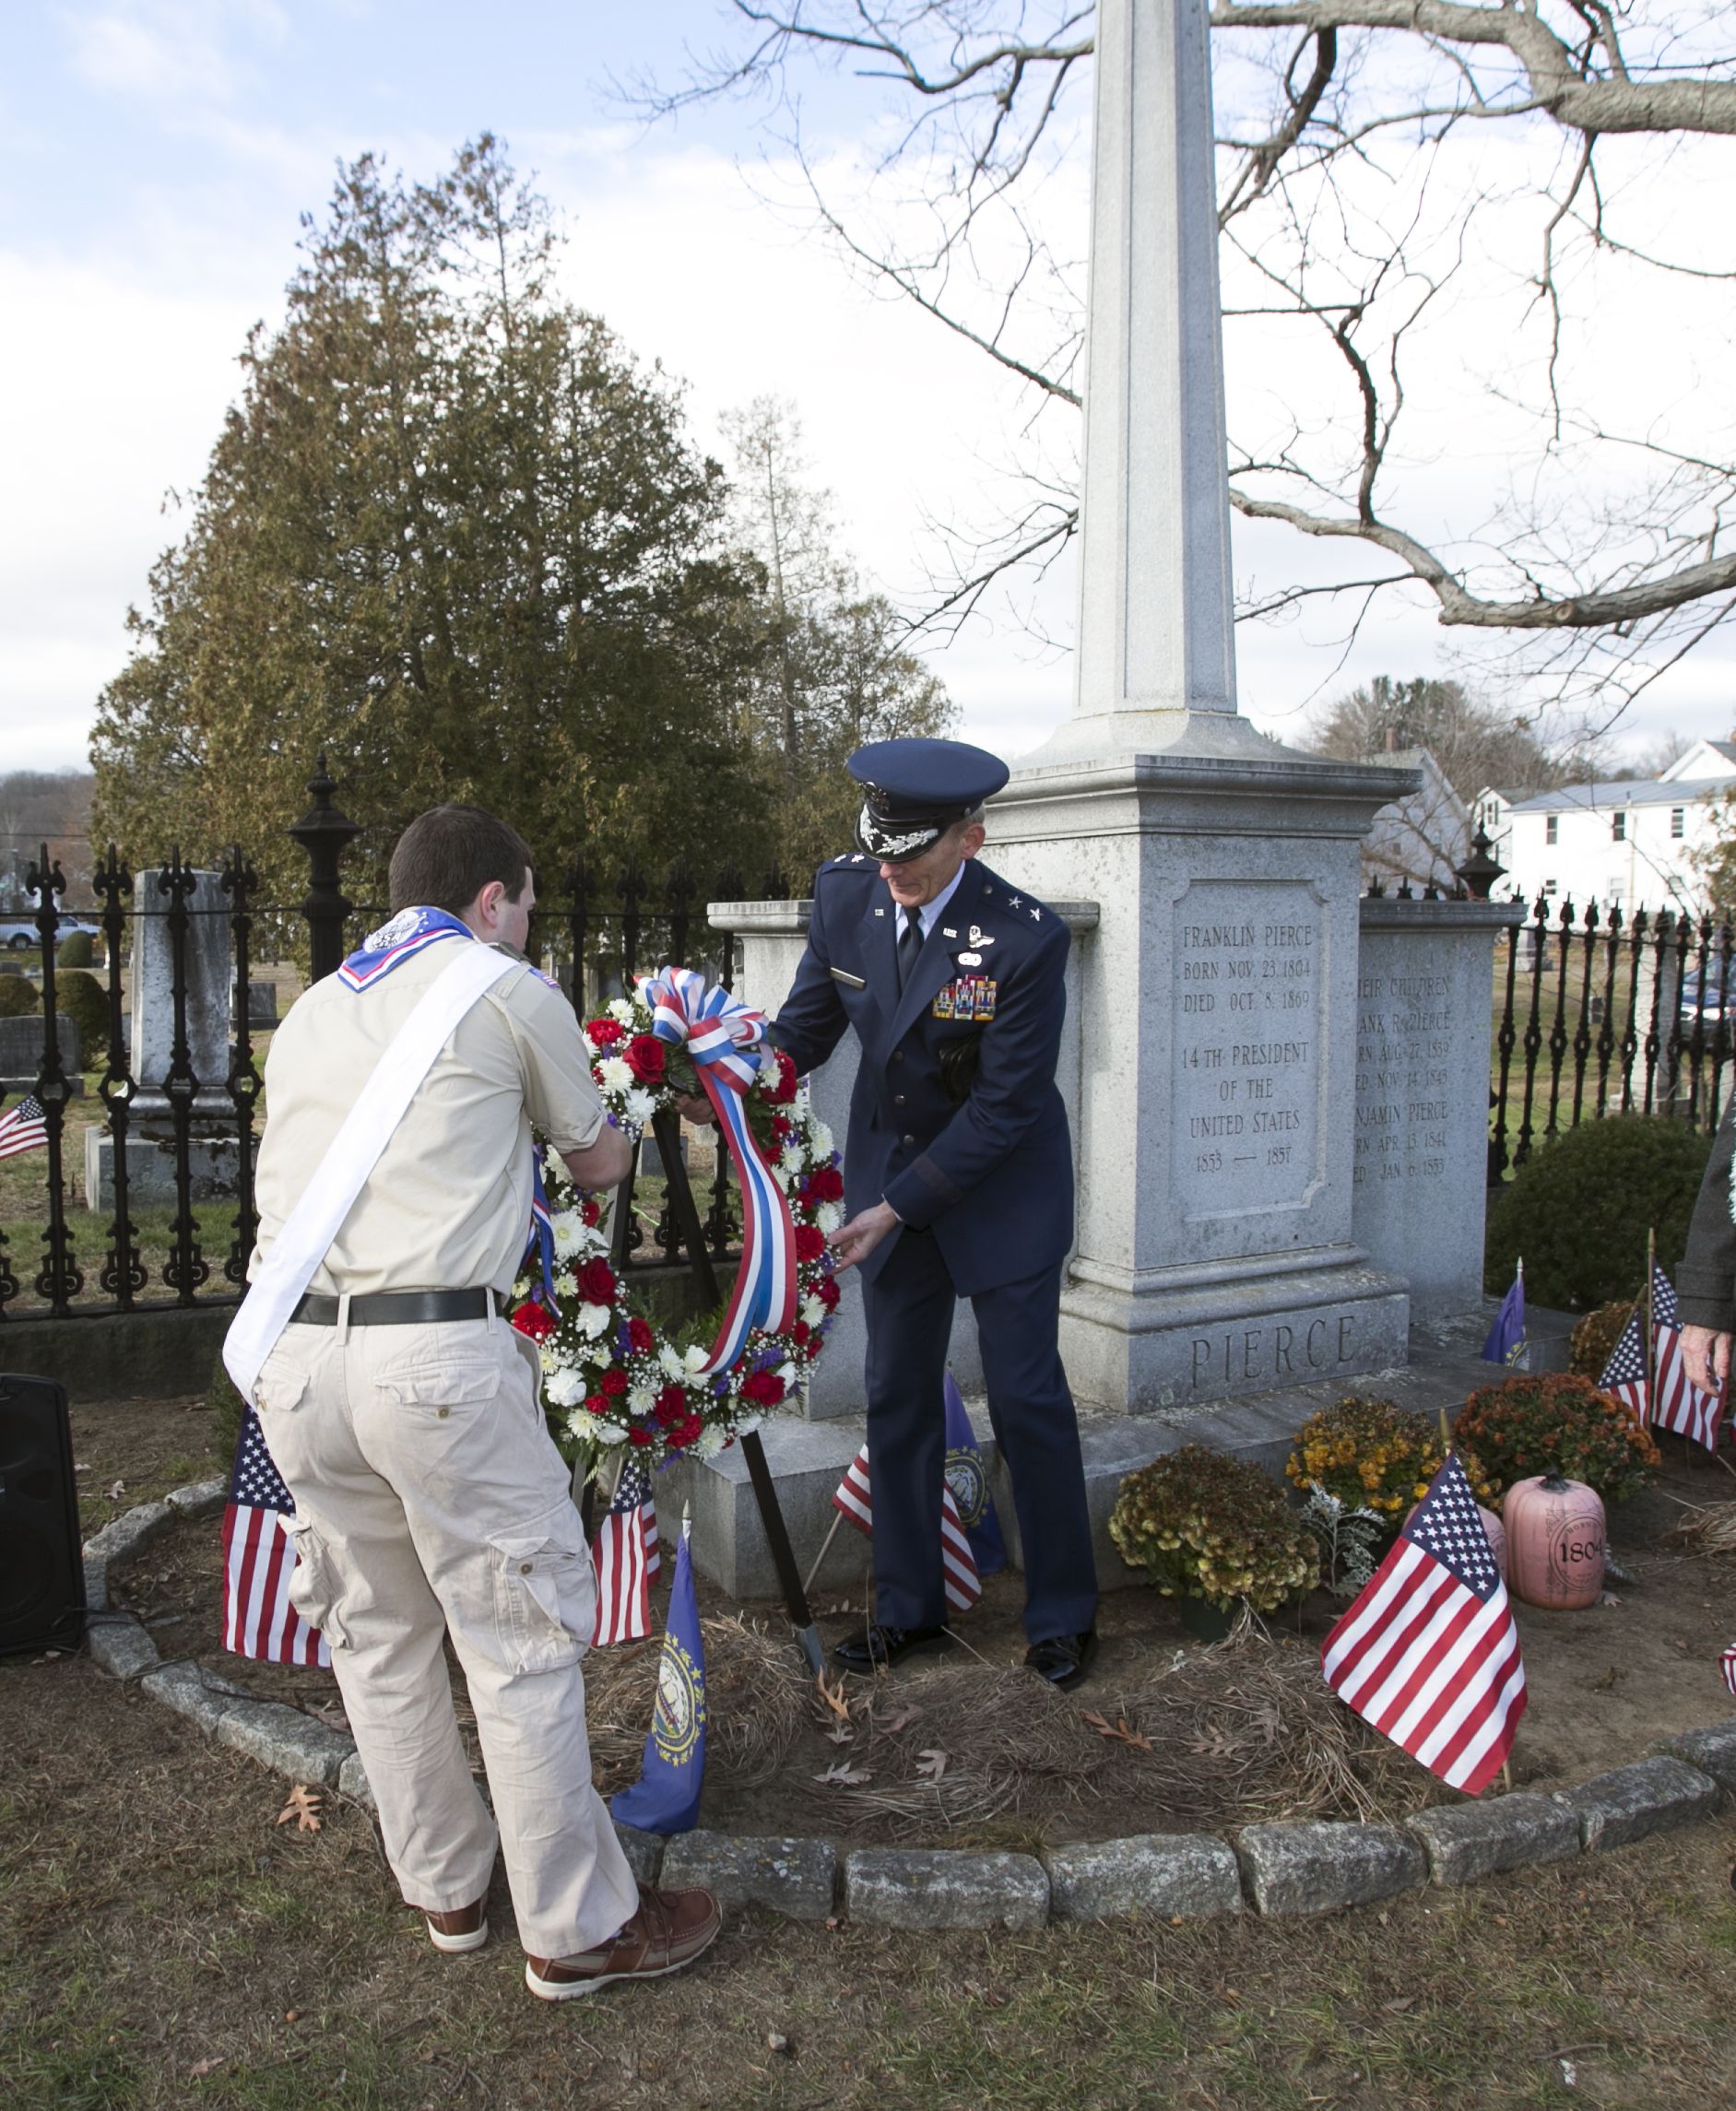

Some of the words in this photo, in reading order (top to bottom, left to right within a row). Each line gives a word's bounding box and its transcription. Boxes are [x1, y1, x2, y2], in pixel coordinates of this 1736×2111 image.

[1183, 926, 1256, 948] FRANKLIN
[1264, 925, 1313, 947] PIERCE
[1183, 961, 1220, 980] BORN
[1282, 959, 1311, 978] 1804
[1389, 976, 1450, 997] CHILDREN
[1183, 994, 1216, 1013] DIED
[1281, 989, 1310, 1009] 1869
[1409, 1010, 1450, 1031] PIERCE
[1232, 1042, 1309, 1066] PRESIDENT
[1219, 1079, 1237, 1101] OF
[1246, 1078, 1273, 1100] THE
[1189, 1114, 1244, 1138] UNITED
[1253, 1109, 1300, 1134] STATES
[1355, 1105, 1400, 1127] NJAMIN
[1407, 1101, 1448, 1122] PIERCE
[1196, 1150, 1223, 1173] 1853
[1267, 1146, 1292, 1166] 1857
[1191, 1315, 1356, 1389] PIERCE
[1558, 1539, 1602, 1563] 1804
